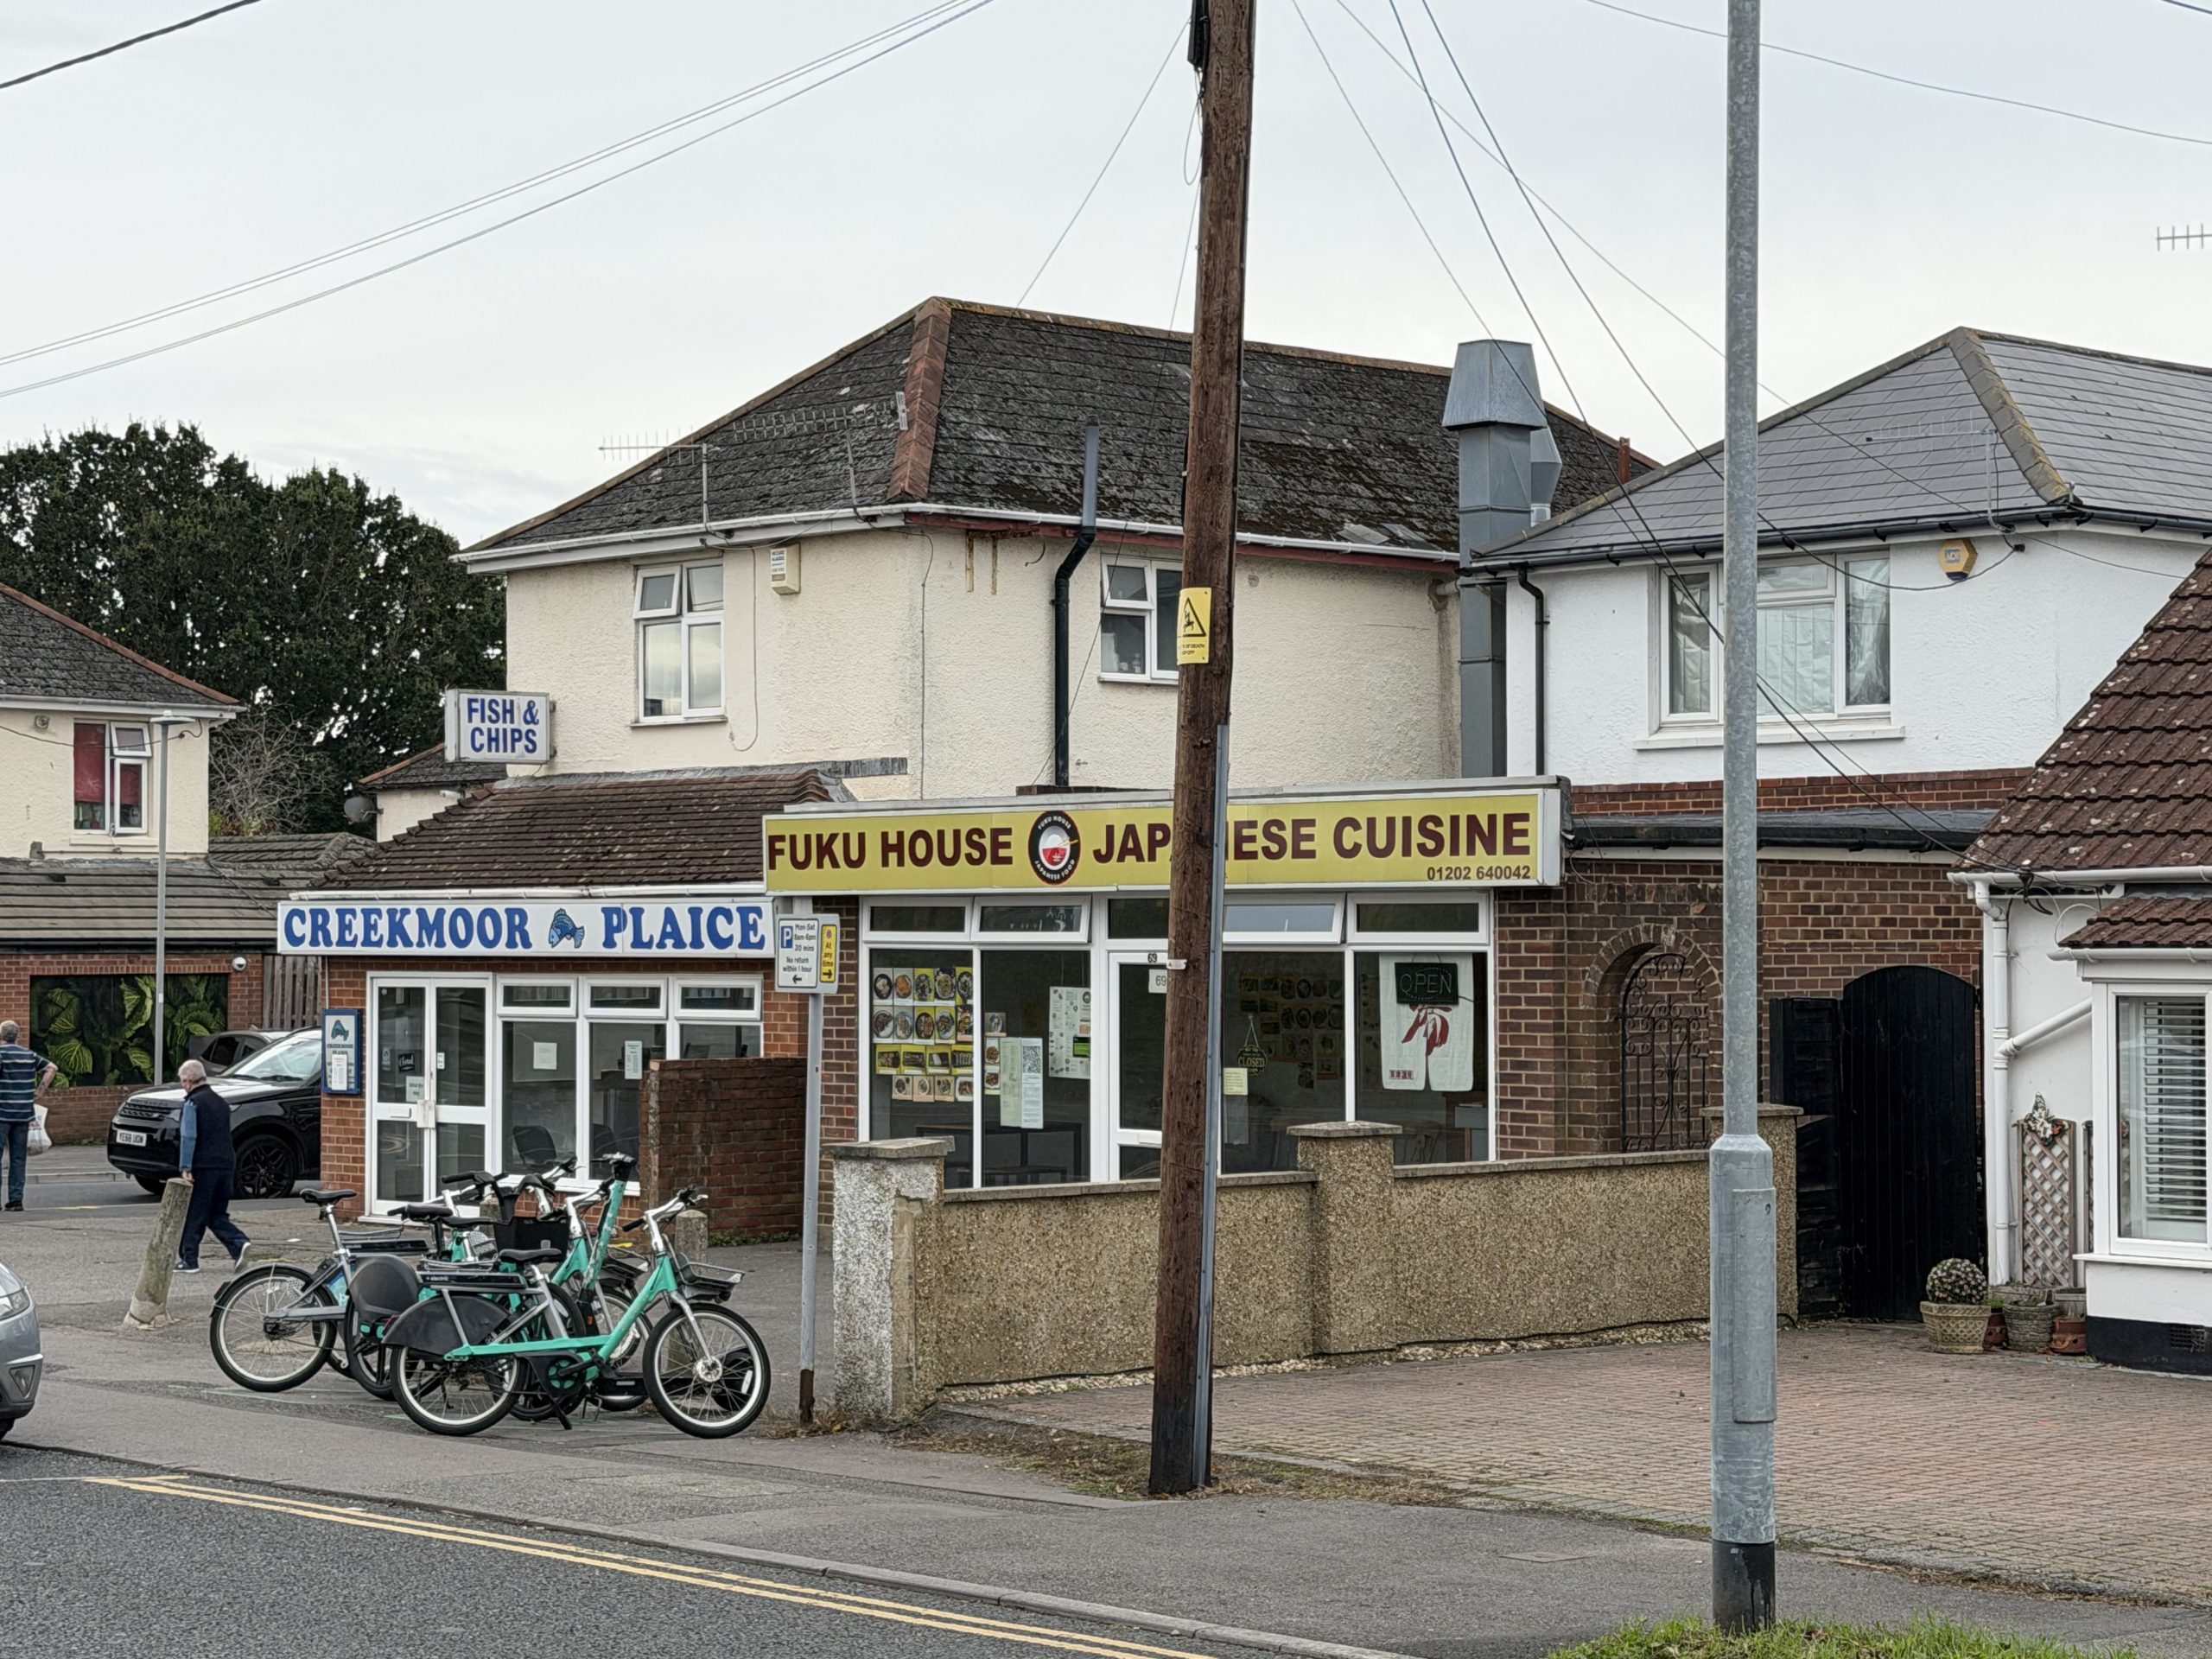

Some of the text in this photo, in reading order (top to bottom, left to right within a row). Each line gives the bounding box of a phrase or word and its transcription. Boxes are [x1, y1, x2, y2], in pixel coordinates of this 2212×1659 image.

[467, 698, 539, 726] FISH &
[470, 727, 537, 753] CHIPS
[1038, 816, 1071, 830] FUKU HOUSE
[767, 827, 1013, 870] FUKU HOUSE
[1093, 812, 1530, 863] JAPESE CUISINE
[1034, 859, 1075, 881] JAPANESE FOOD
[1427, 864, 1531, 880] 01202 640042
[283, 906, 766, 950] CREEKMOOR PLAICE
[1155, 975, 1166, 987] 69
[1400, 973, 1452, 995] OPEN
[1237, 1057, 1265, 1068] CLOSED
